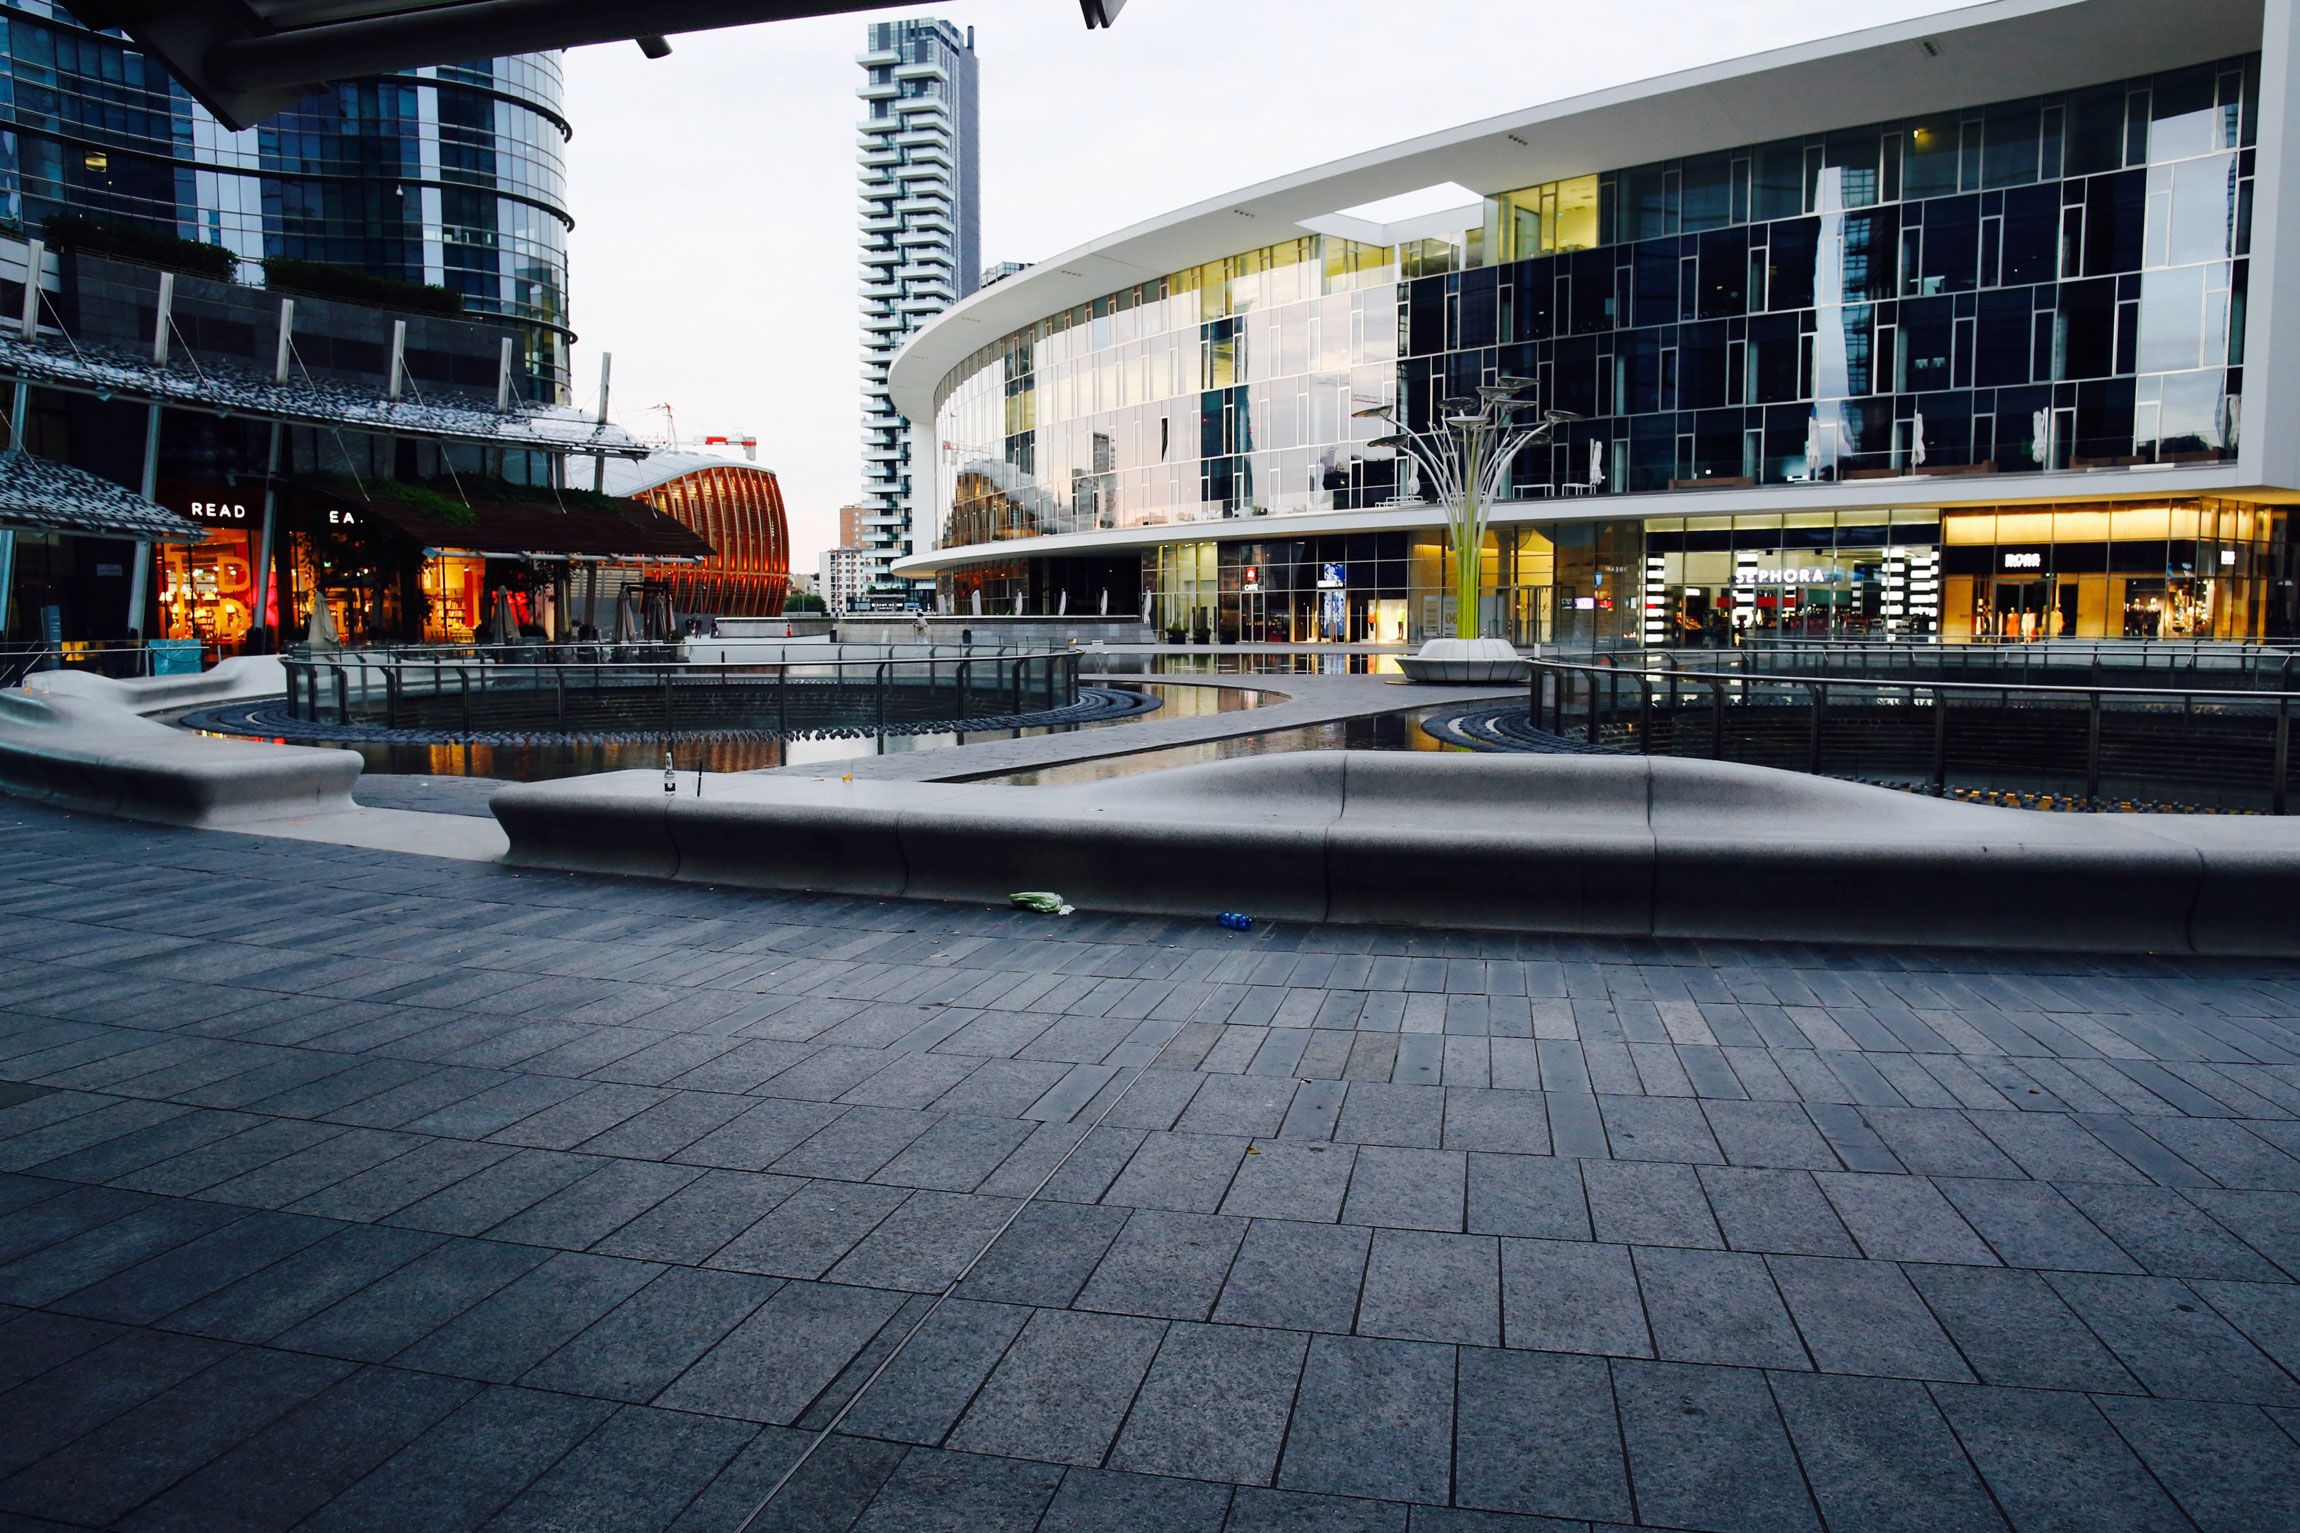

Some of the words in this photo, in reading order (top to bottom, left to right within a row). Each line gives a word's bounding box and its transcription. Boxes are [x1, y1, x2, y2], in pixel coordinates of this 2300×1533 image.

[191, 502, 245, 518] READ
[329, 510, 363, 524] EA
[1735, 567, 1825, 584] SEPHORA
